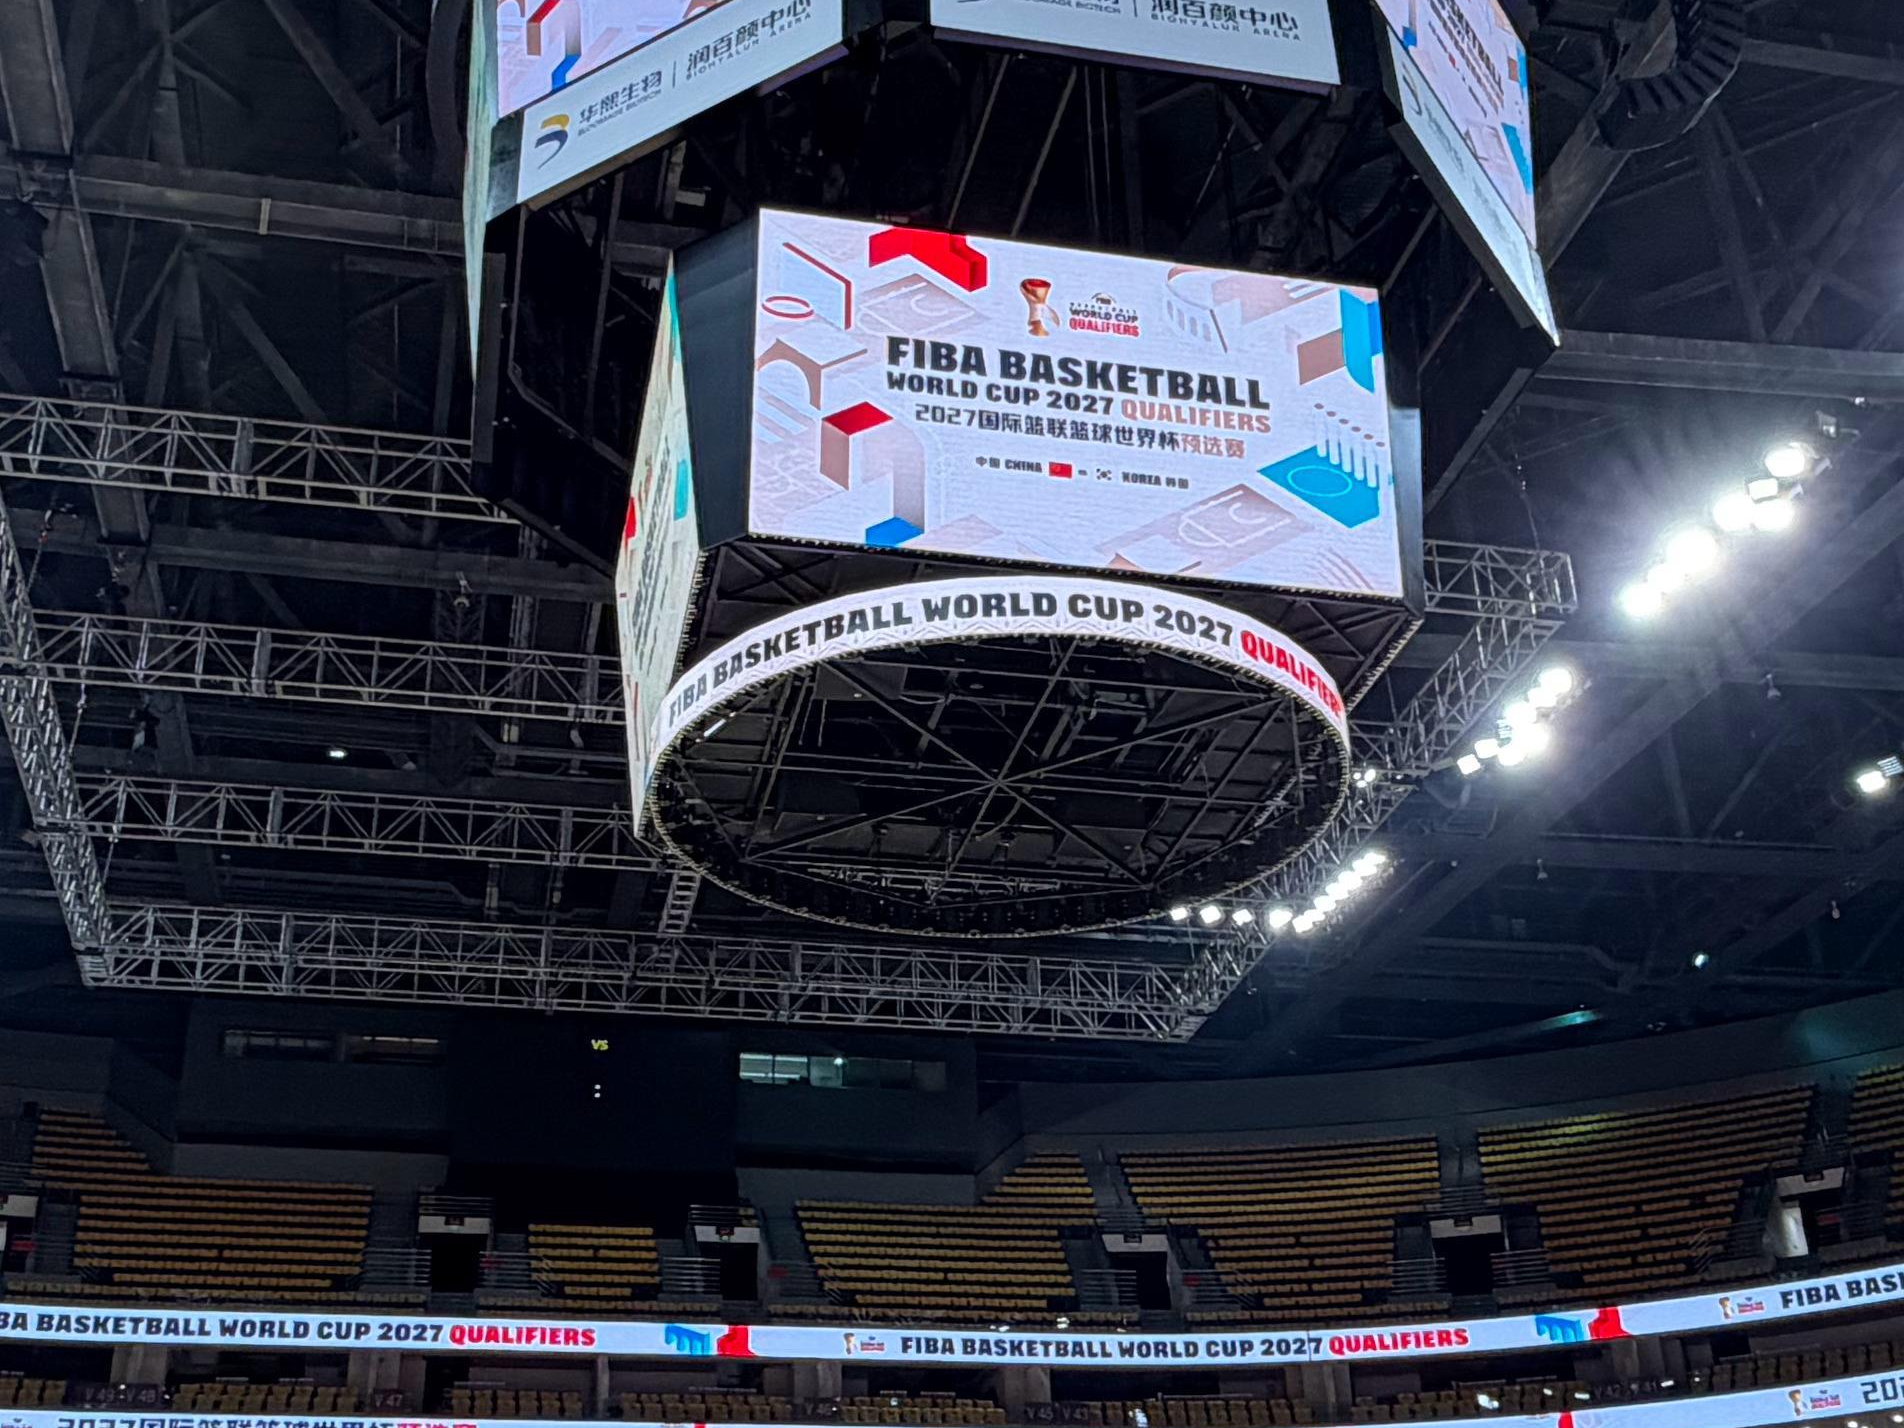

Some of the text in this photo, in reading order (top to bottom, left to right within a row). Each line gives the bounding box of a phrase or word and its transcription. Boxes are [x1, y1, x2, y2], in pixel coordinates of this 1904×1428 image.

[579, 71, 663, 125] 华熙生物
[1069, 307, 1112, 320] WORLD
[1114, 313, 1138, 323] CUP
[1069, 317, 1139, 337] QUALIFIERS
[886, 336, 1271, 411] FIBA BASKETBALL
[886, 371, 1272, 433] WORLD CUP 2027 QUALIFIERS
[915, 403, 1247, 459] 2027国际篮联篮球世界杯预选赛
[1004, 459, 1042, 473] CHINA
[668, 592, 1234, 725] FIBA BASKETBALL WORLD CUP 2027
[1780, 1284, 1842, 1310] FIBA
[35, 1311, 212, 1338] BASKETBALL
[218, 1318, 311, 1340] WORLD
[316, 1320, 371, 1341] CUP
[377, 1322, 443, 1343] 2027
[448, 1323, 597, 1348] QUALIFIERS
[900, 1335, 955, 1356] FIBA
[962, 1337, 1113, 1359] BASKETBALL
[1117, 1338, 1199, 1359] WORLD
[1205, 1338, 1255, 1358] CUP
[1260, 1334, 1323, 1358] 2027
[1328, 1327, 1471, 1355] QUALIFIERS
